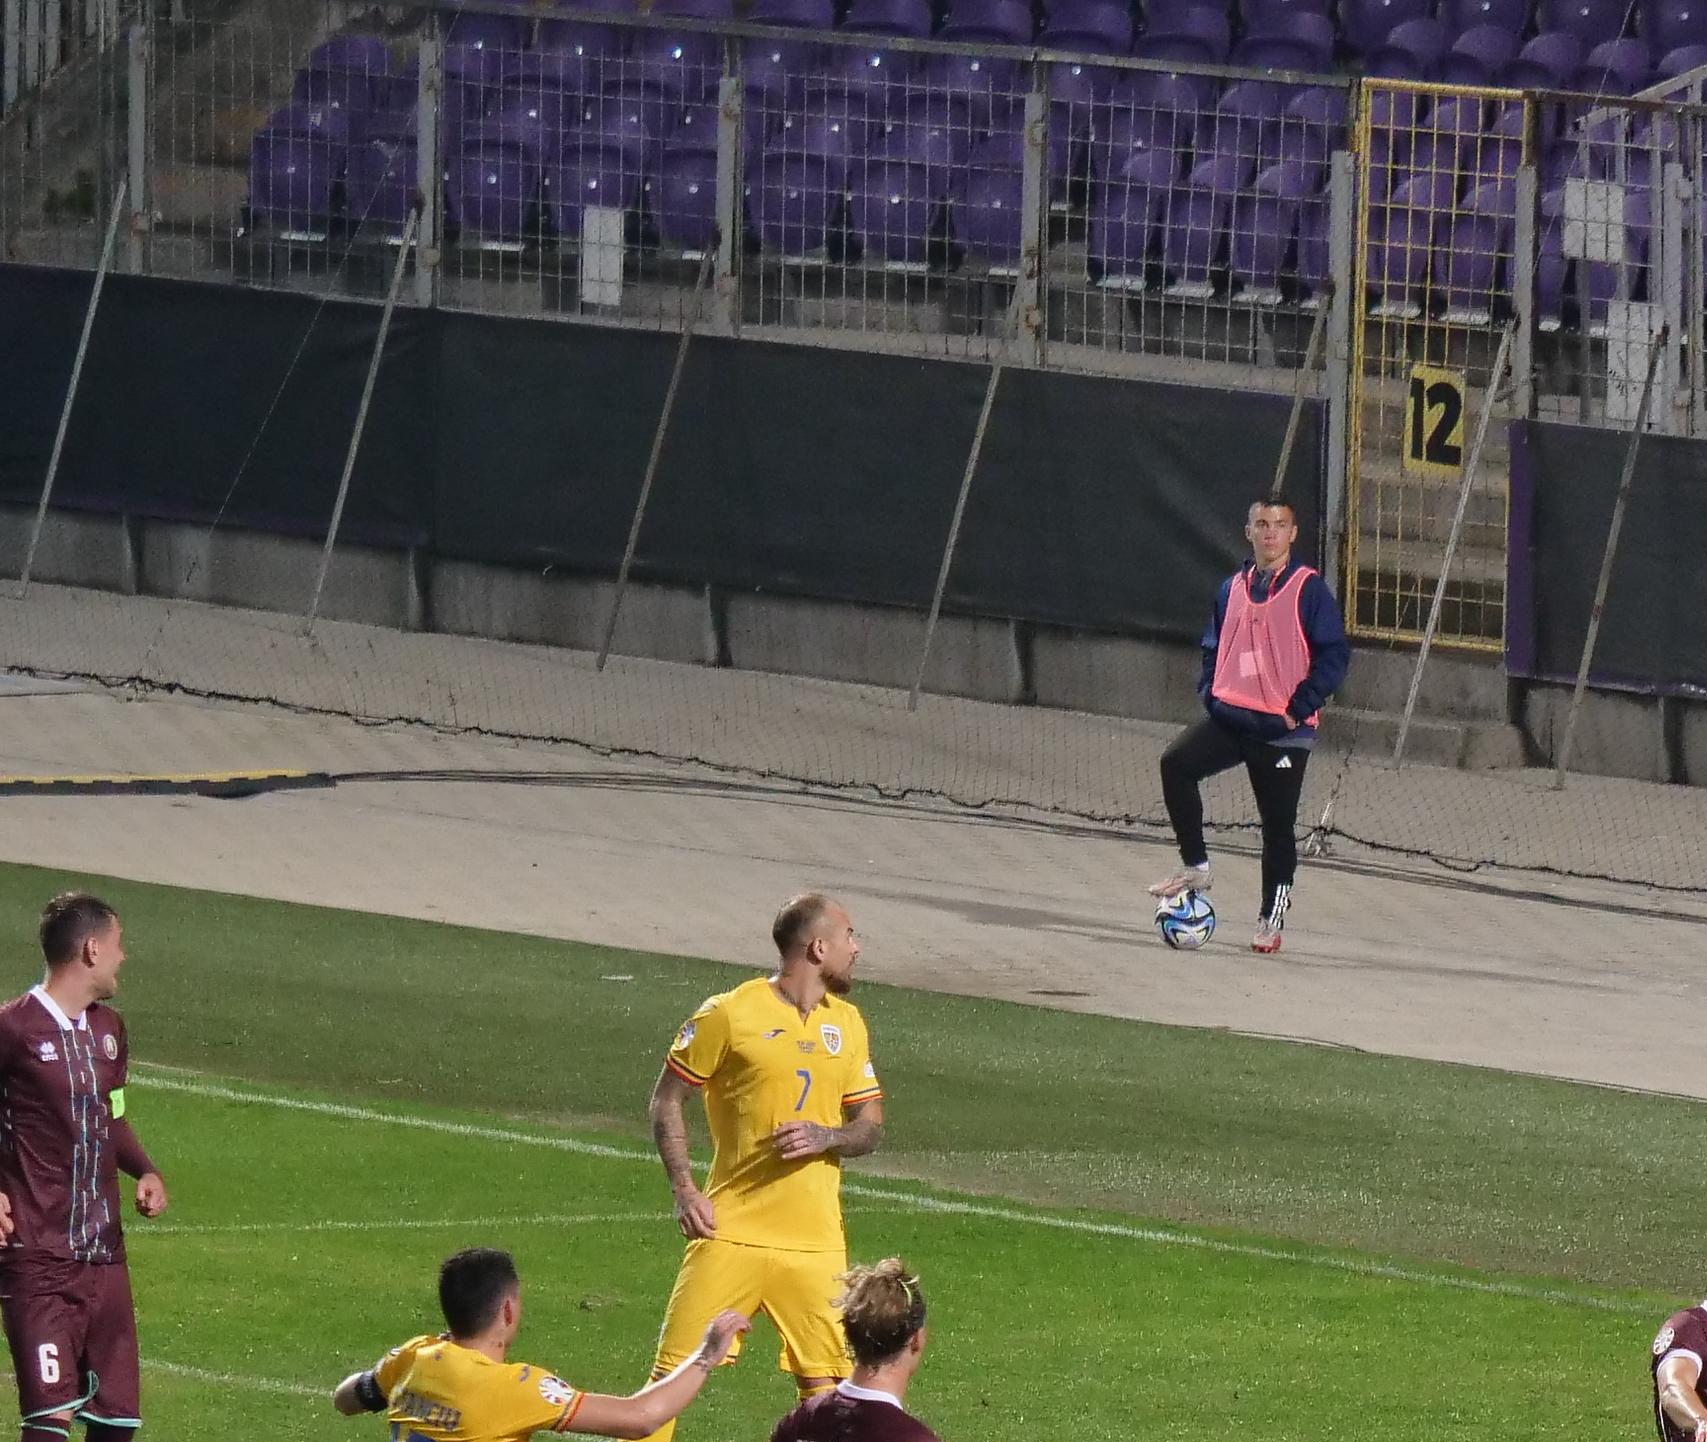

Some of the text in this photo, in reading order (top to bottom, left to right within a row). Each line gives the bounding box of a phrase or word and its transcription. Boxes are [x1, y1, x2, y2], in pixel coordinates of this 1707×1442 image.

[1410, 377, 1462, 466] 12
[795, 1069, 812, 1112] 7
[38, 1343, 60, 1384] 6
